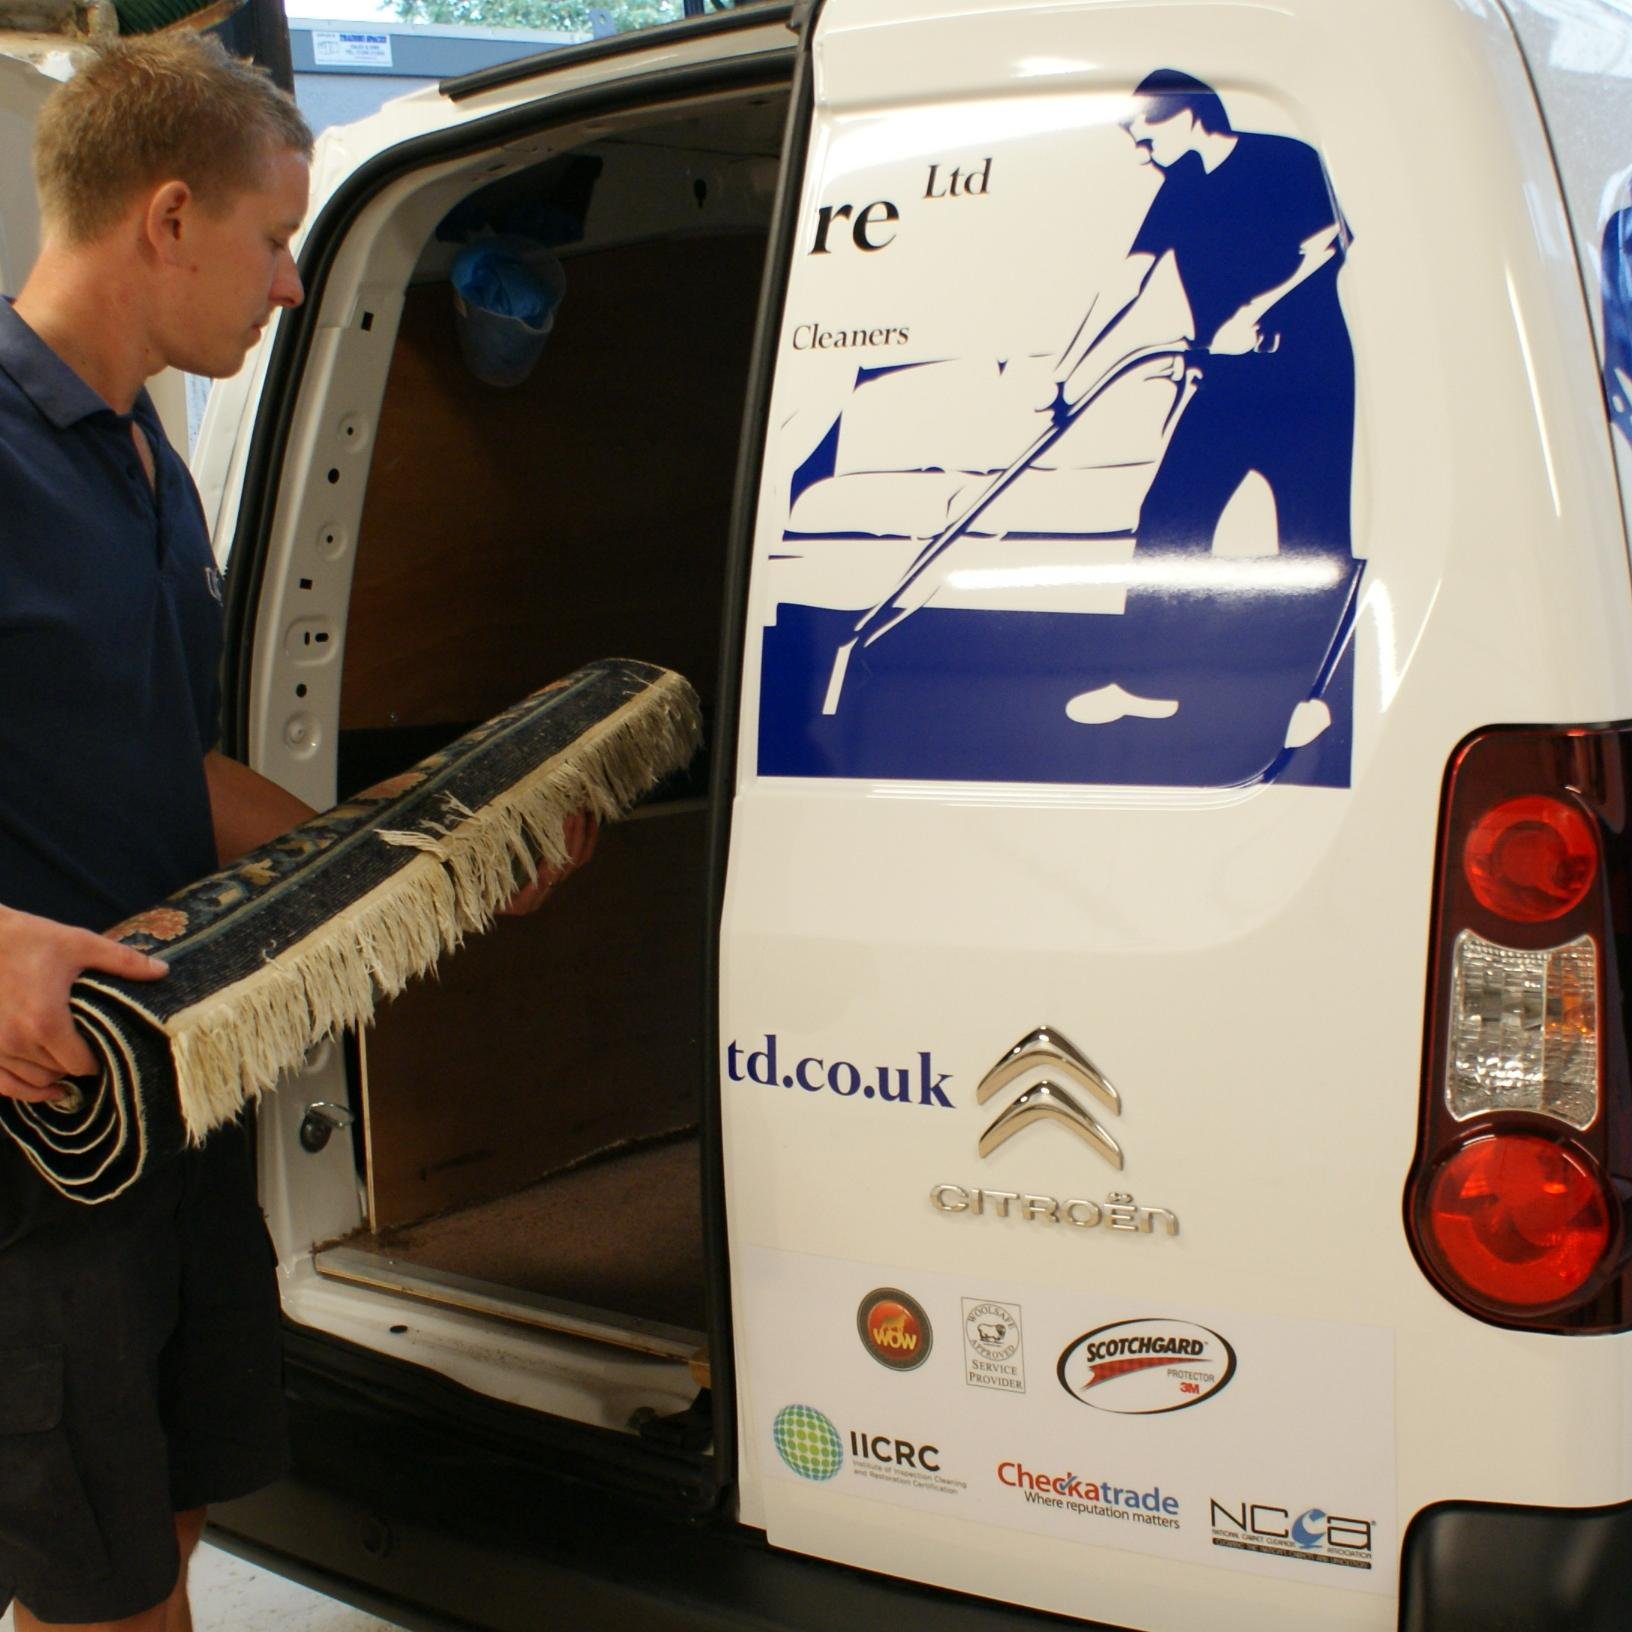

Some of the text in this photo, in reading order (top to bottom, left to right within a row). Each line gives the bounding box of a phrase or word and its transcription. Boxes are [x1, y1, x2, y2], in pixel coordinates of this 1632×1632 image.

[922, 157, 992, 199] Ltd
[808, 200, 900, 256] re
[792, 323, 910, 351] Cleaners
[727, 1034, 956, 1109] td.co.uk
[967, 1303, 1016, 1330] WOOLSAFE
[873, 1327, 917, 1351] WOW
[970, 1339, 1016, 1360] APPROVED
[1087, 1336, 1204, 1363] SCOTCHGARD
[968, 1370, 1024, 1390] PROVIDER
[971, 1358, 1018, 1377] SERVICE
[1167, 1367, 1216, 1383] PROTECTOR
[1179, 1381, 1201, 1395] 3M
[850, 1430, 941, 1473] IICRC
[934, 1474, 968, 1490] Cleaning
[997, 1462, 1180, 1515] Checkatrade
[1024, 1491, 1181, 1530] Where reputation matters
